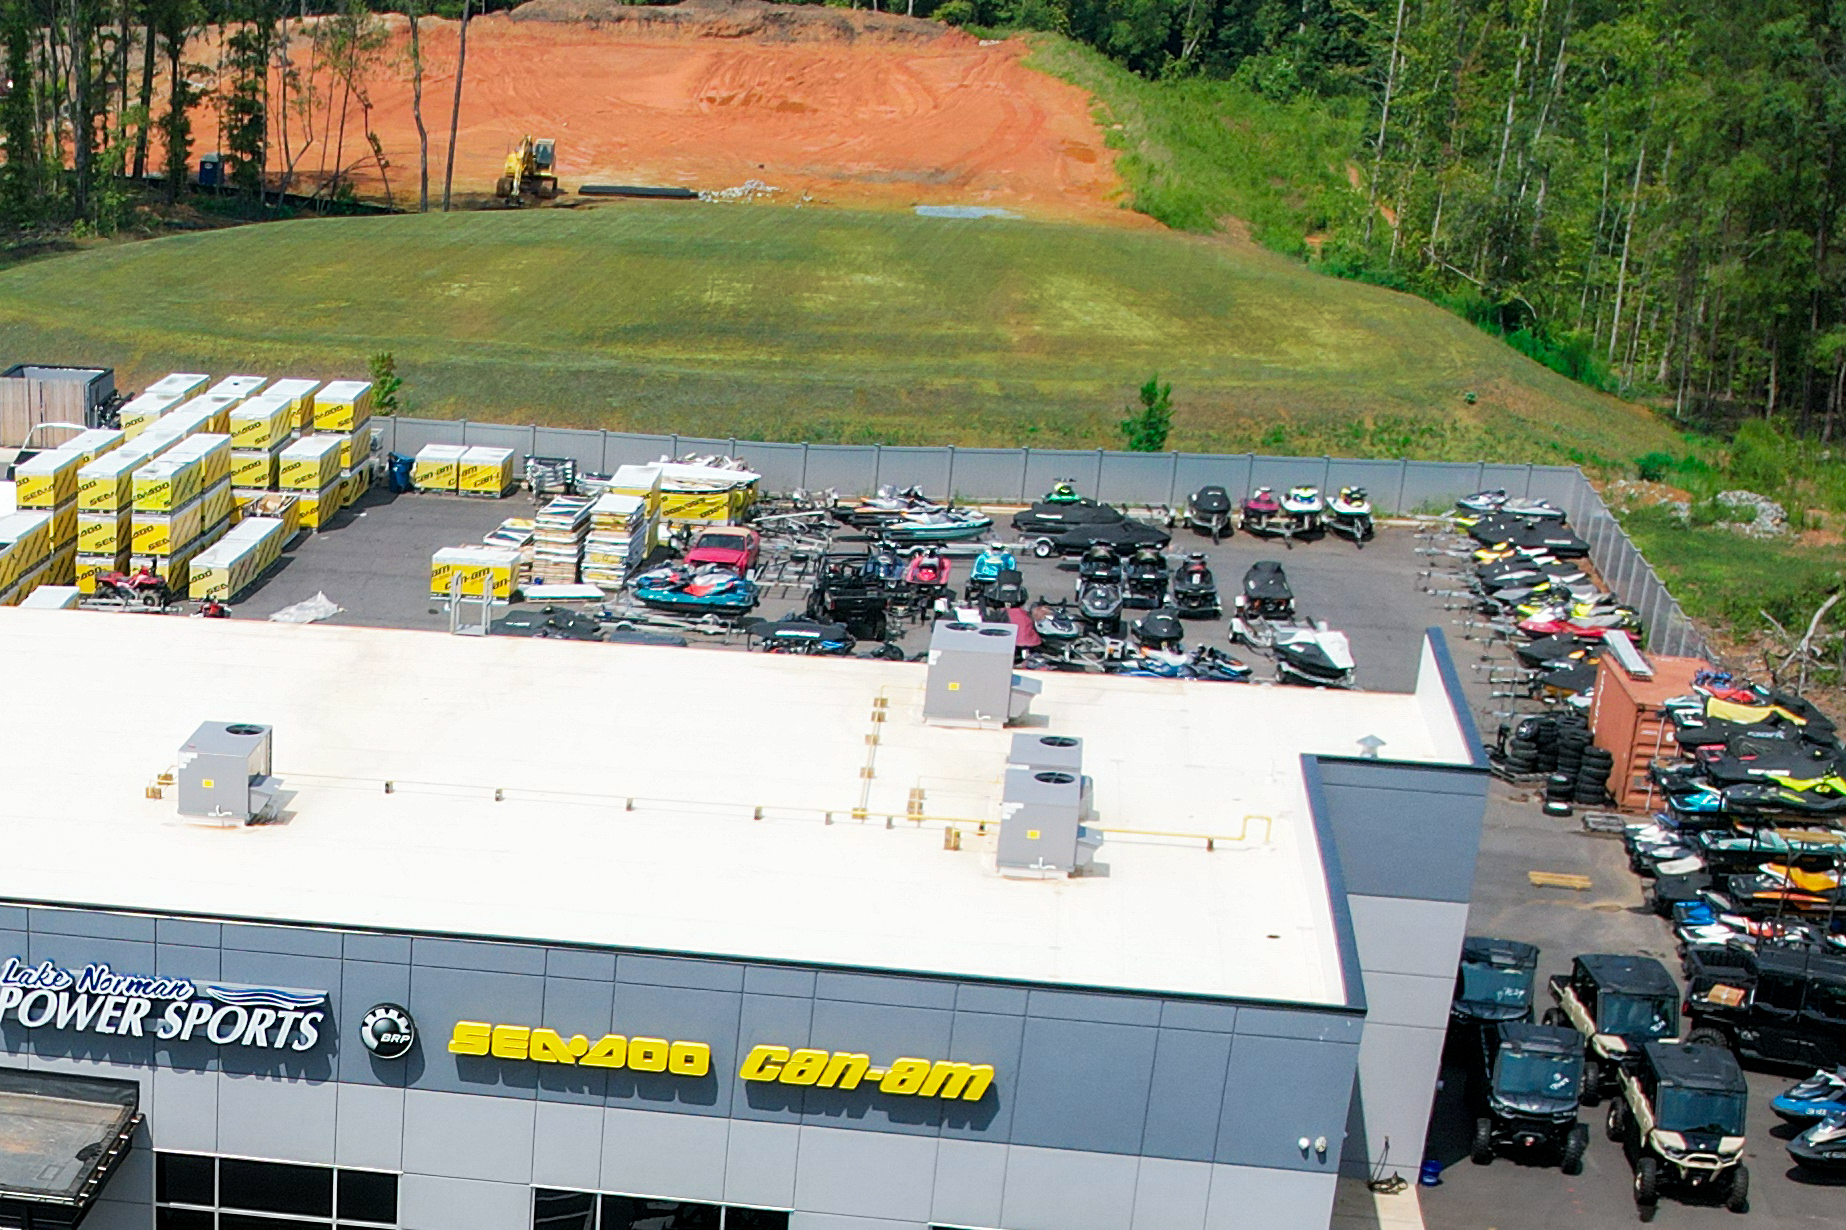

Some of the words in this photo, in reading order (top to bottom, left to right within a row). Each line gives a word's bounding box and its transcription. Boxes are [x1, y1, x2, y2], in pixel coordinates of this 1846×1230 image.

[0, 955, 72, 989] Lake
[76, 961, 195, 1001] Norman
[156, 1000, 325, 1052] SPORTS
[379, 1033, 411, 1045] BRP
